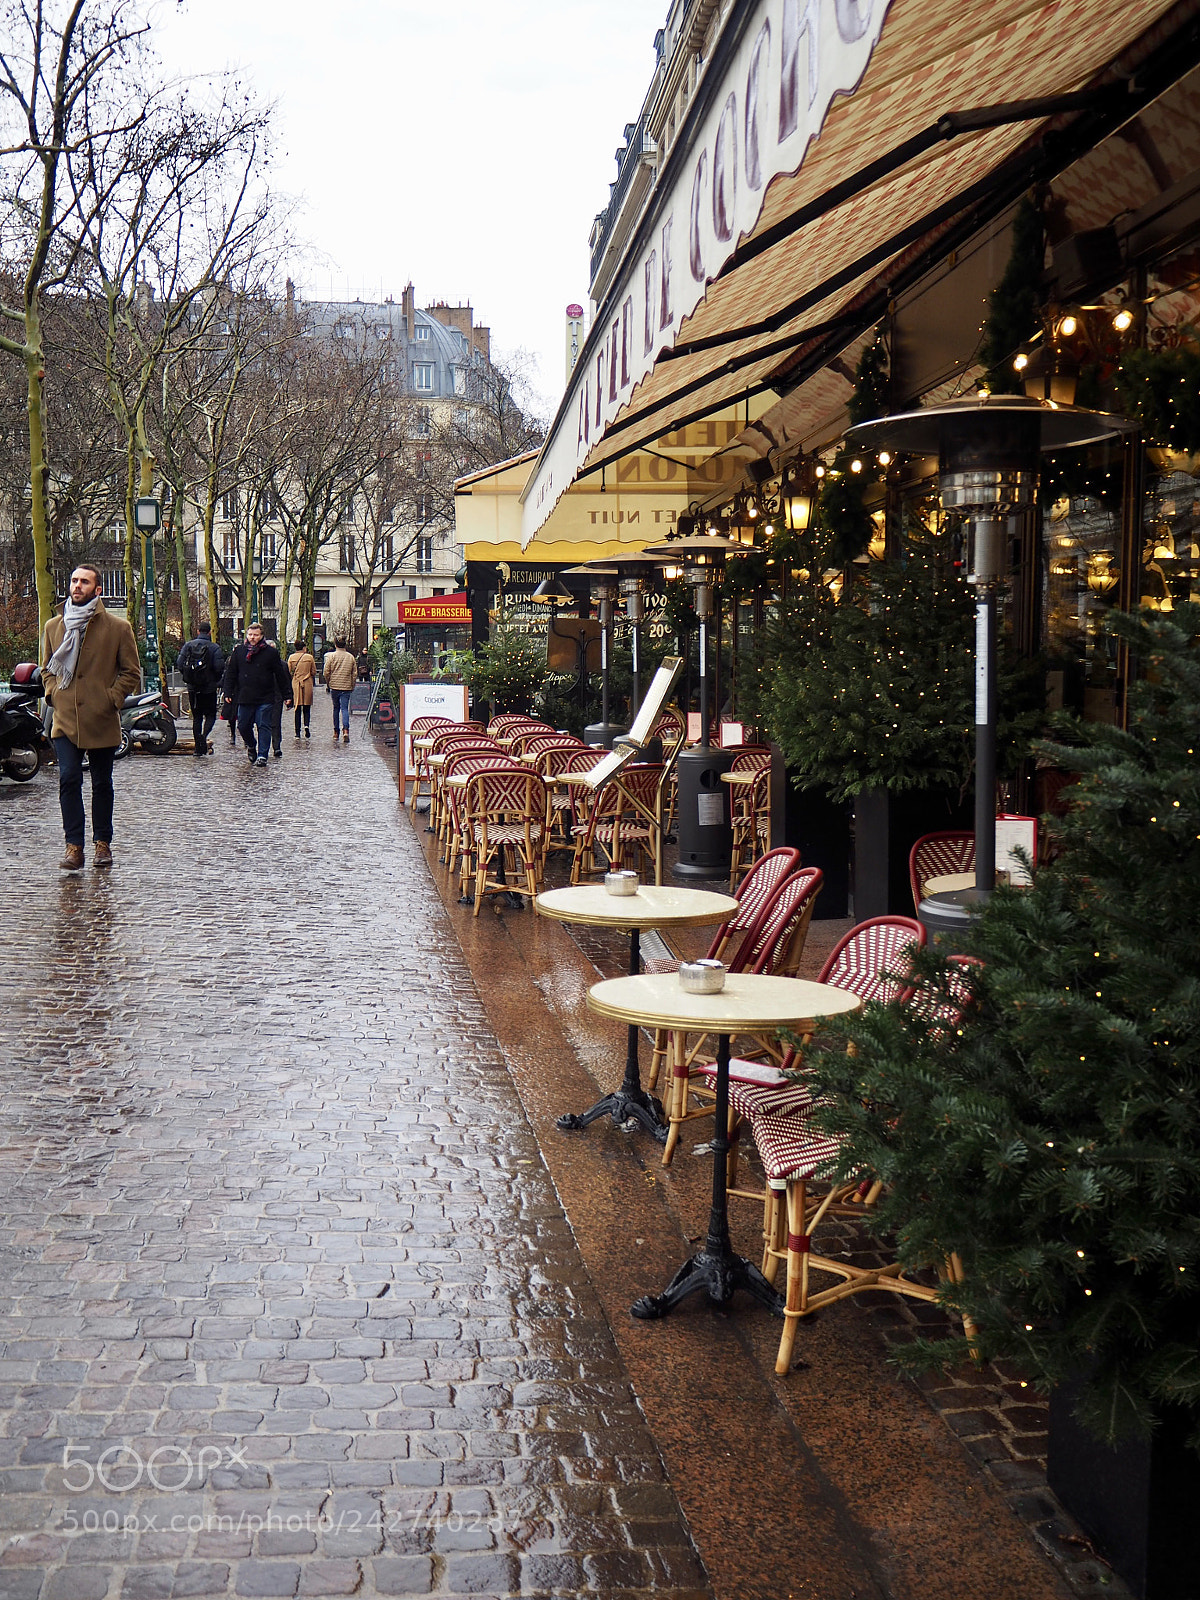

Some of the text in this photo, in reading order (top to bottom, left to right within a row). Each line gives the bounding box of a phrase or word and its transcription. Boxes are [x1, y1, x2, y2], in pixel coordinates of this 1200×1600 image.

[689, 0, 876, 283] COCH
[511, 570, 556, 584] RESTAURANT
[404, 607, 426, 617] PIZZA
[431, 607, 472, 617] BRASSERIE
